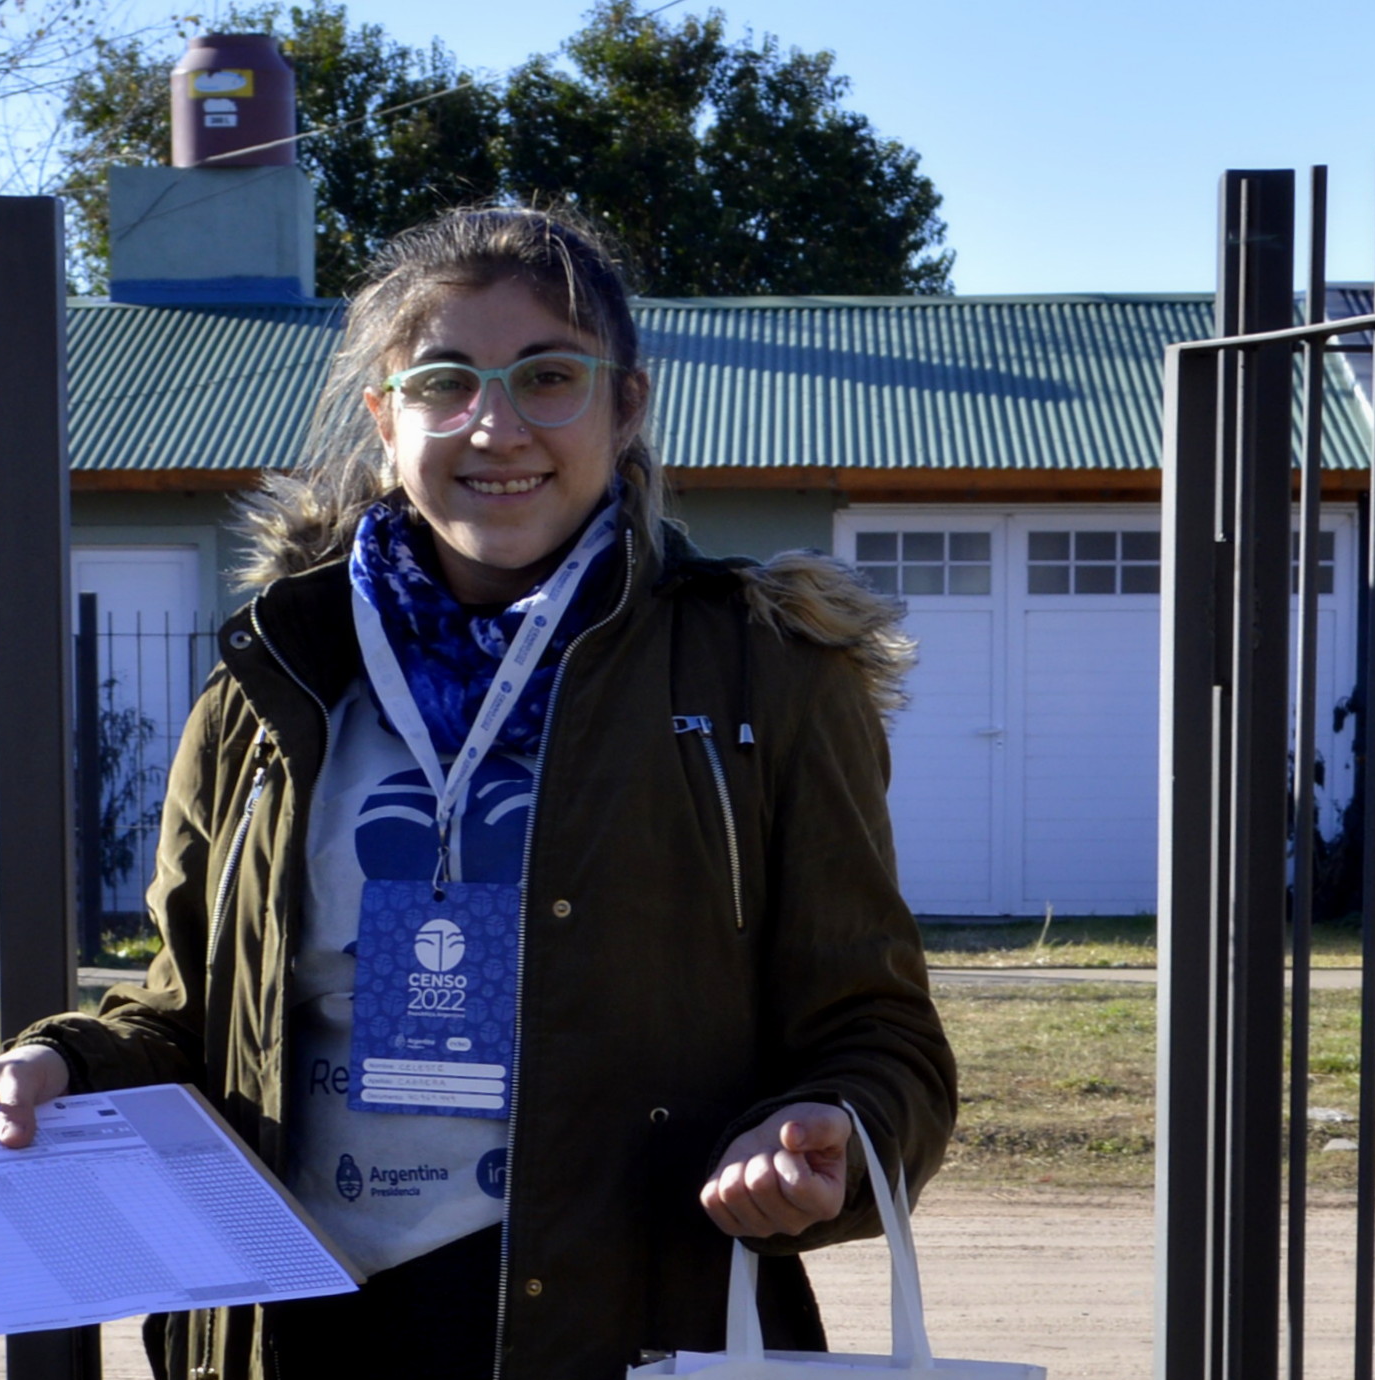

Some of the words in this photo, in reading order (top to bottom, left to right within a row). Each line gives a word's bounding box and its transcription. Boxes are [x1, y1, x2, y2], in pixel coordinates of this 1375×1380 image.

[408, 973, 467, 989] CENSO
[407, 987, 466, 1011] 2022
[370, 1165, 449, 1186] Argentina
[371, 1187, 420, 1197] Presidencia
